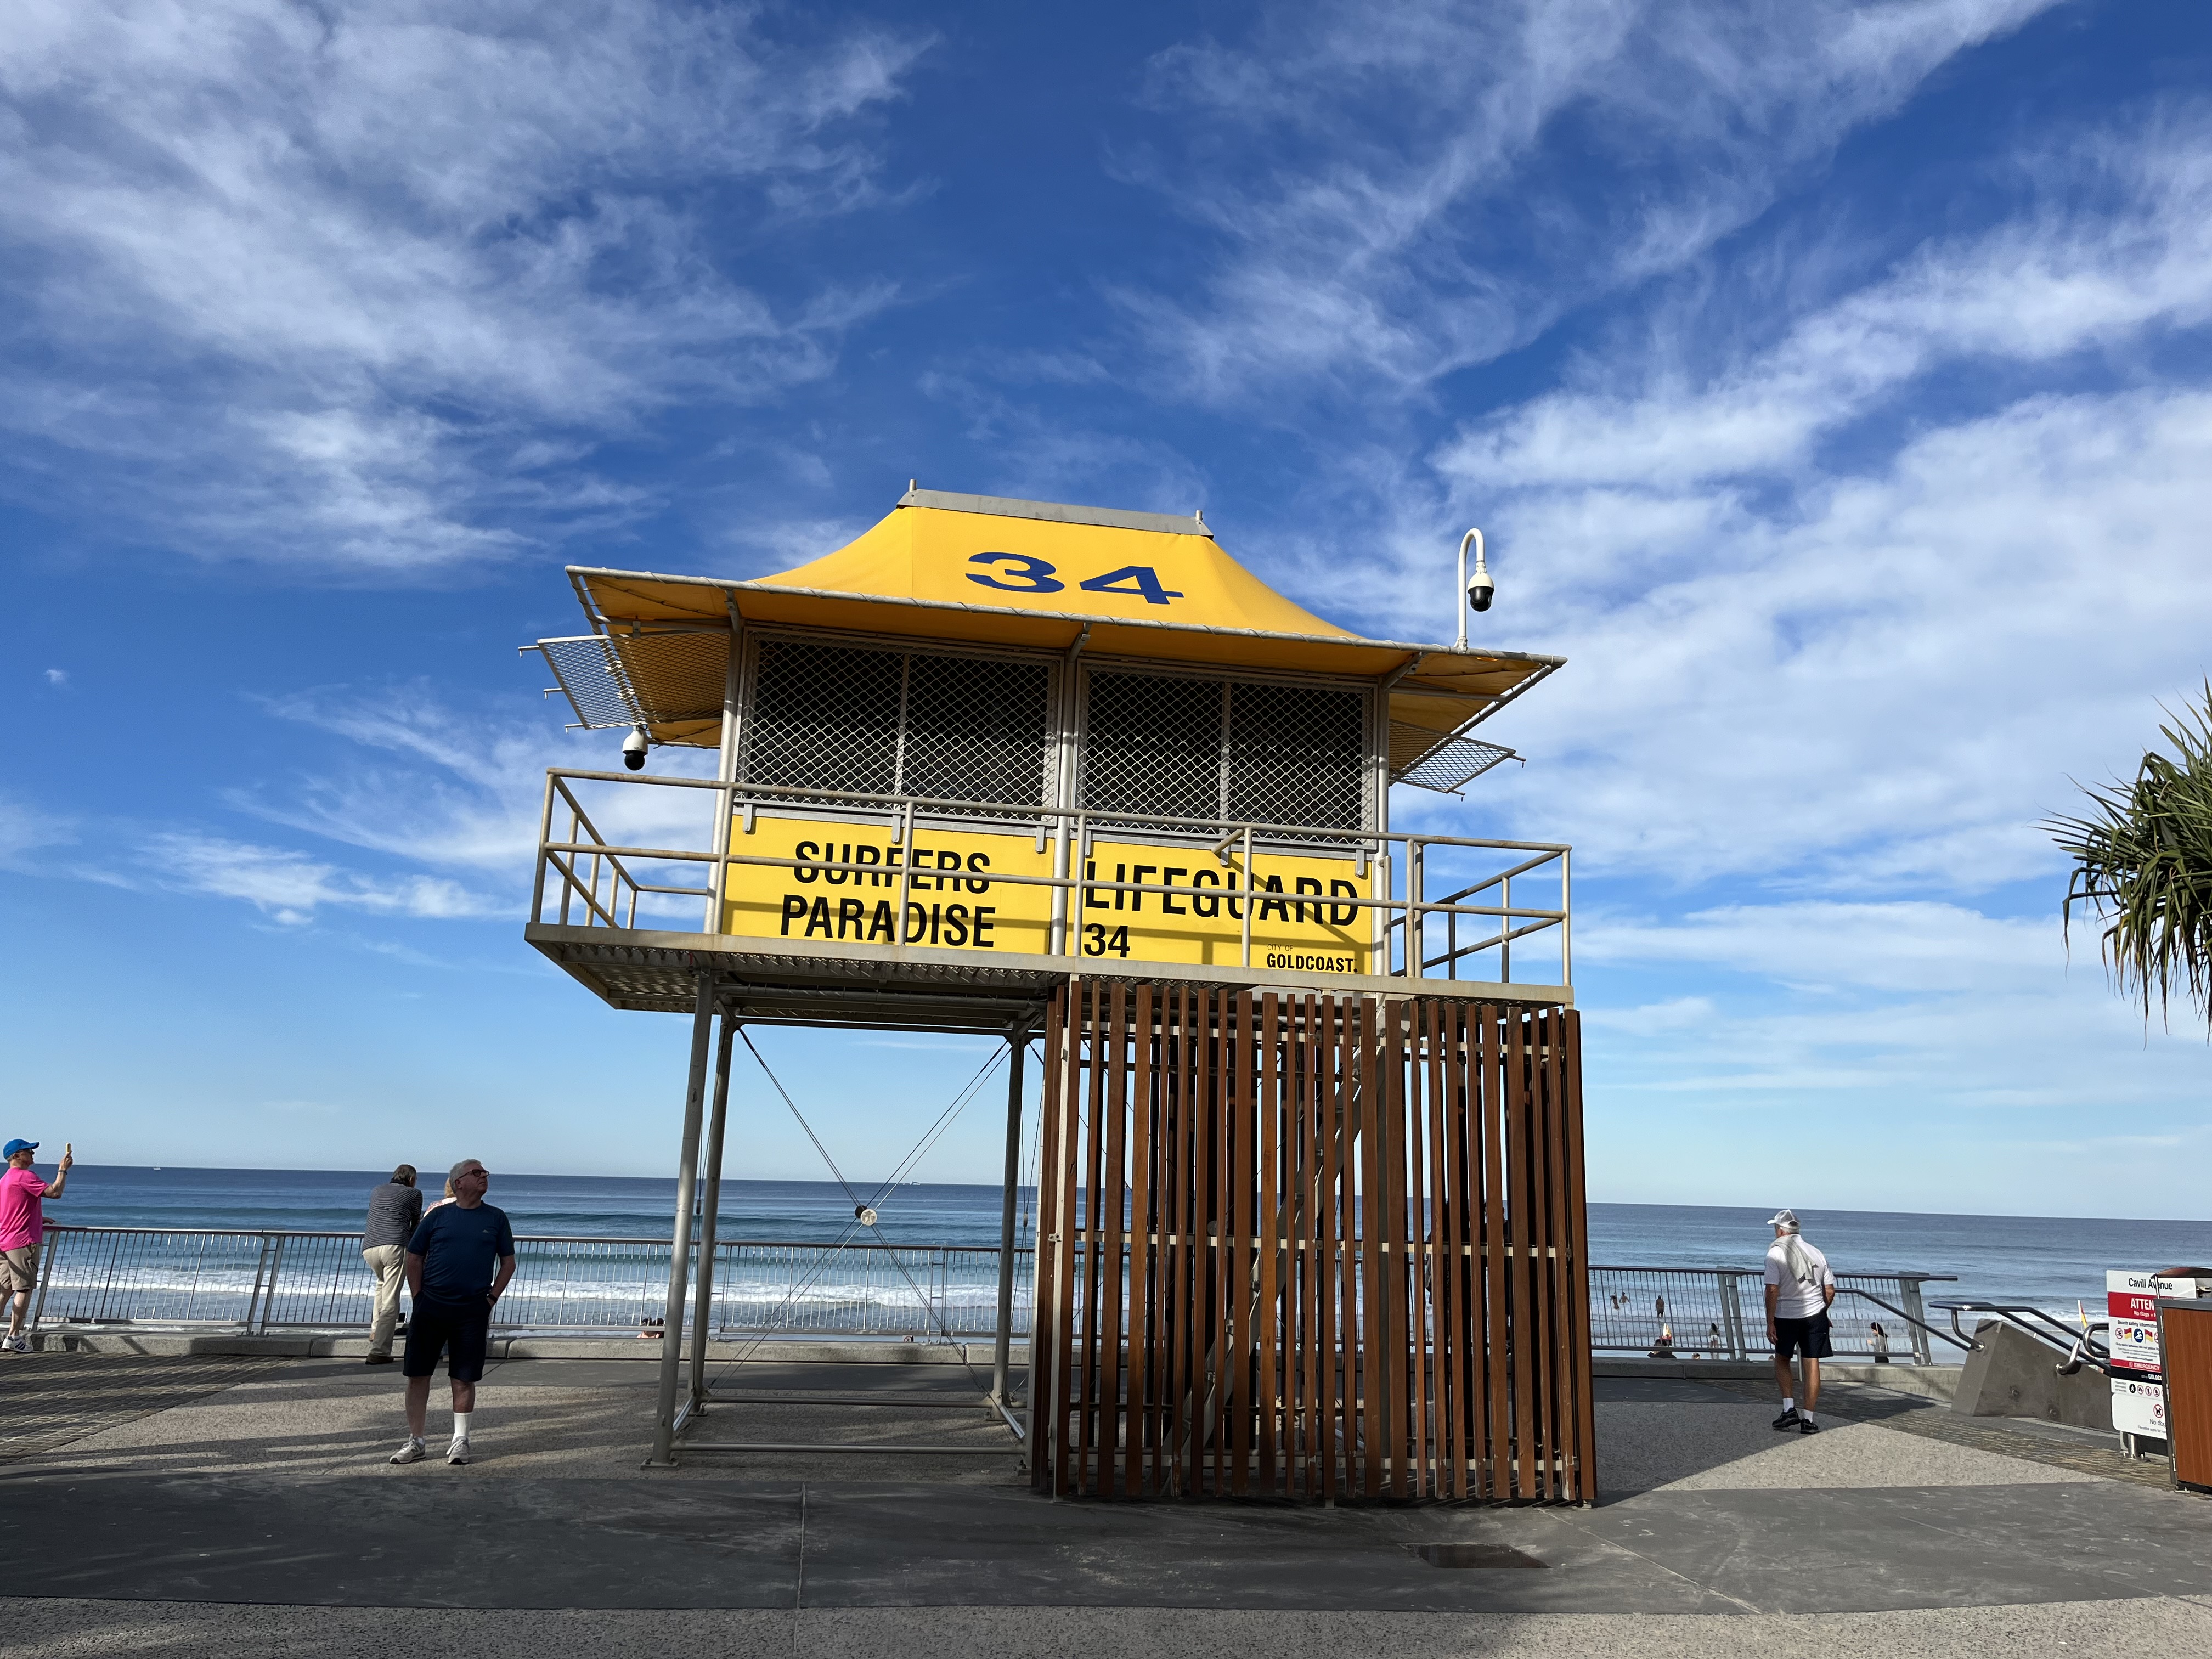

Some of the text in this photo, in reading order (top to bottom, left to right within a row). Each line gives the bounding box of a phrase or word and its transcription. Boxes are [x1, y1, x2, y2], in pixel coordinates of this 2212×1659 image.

[966, 552, 1184, 605] 34
[794, 841, 990, 894] SURFERS
[1085, 861, 1358, 926] LIFEGUARD
[781, 894, 996, 947] PARADISE
[1084, 923, 1130, 958] 34
[2129, 1278, 2146, 1288] Cavill
[2130, 1298, 2155, 1311] ATTEN
